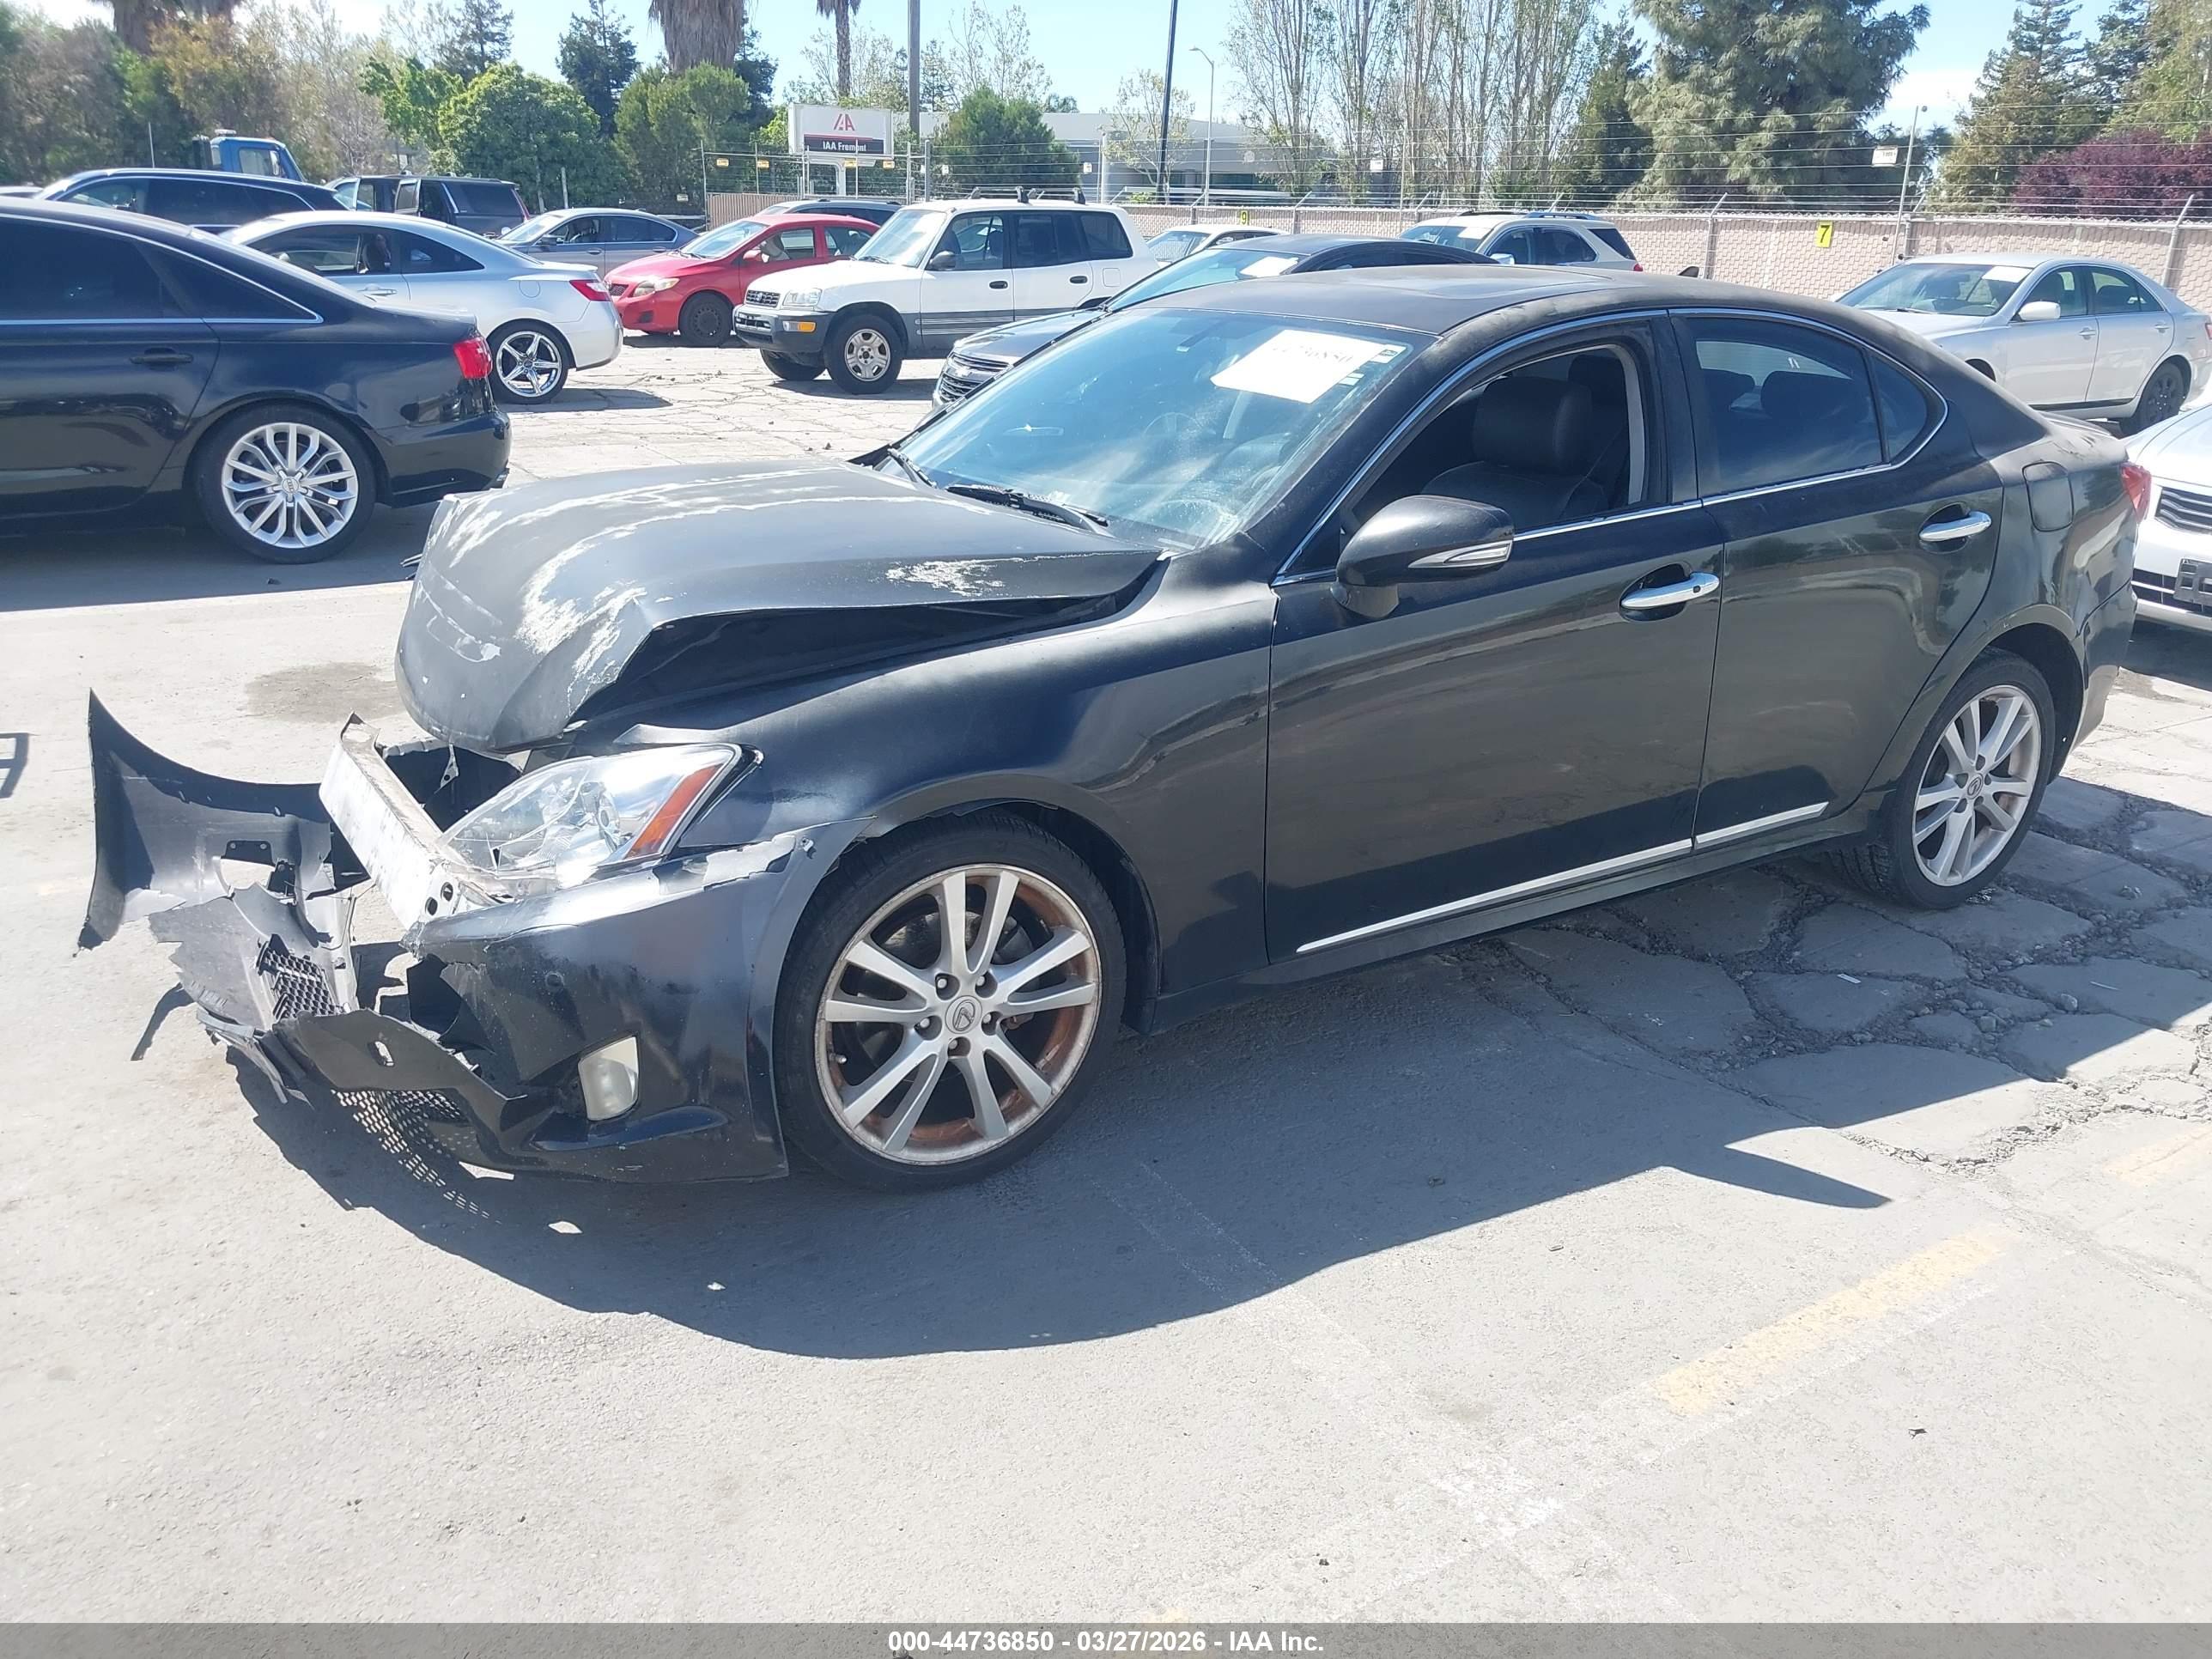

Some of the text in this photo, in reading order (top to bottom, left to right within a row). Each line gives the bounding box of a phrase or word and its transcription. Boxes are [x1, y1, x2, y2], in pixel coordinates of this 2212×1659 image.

[823, 141, 837, 150] IAA
[1242, 211, 1247, 225] 9
[1820, 225, 1831, 243] 7
